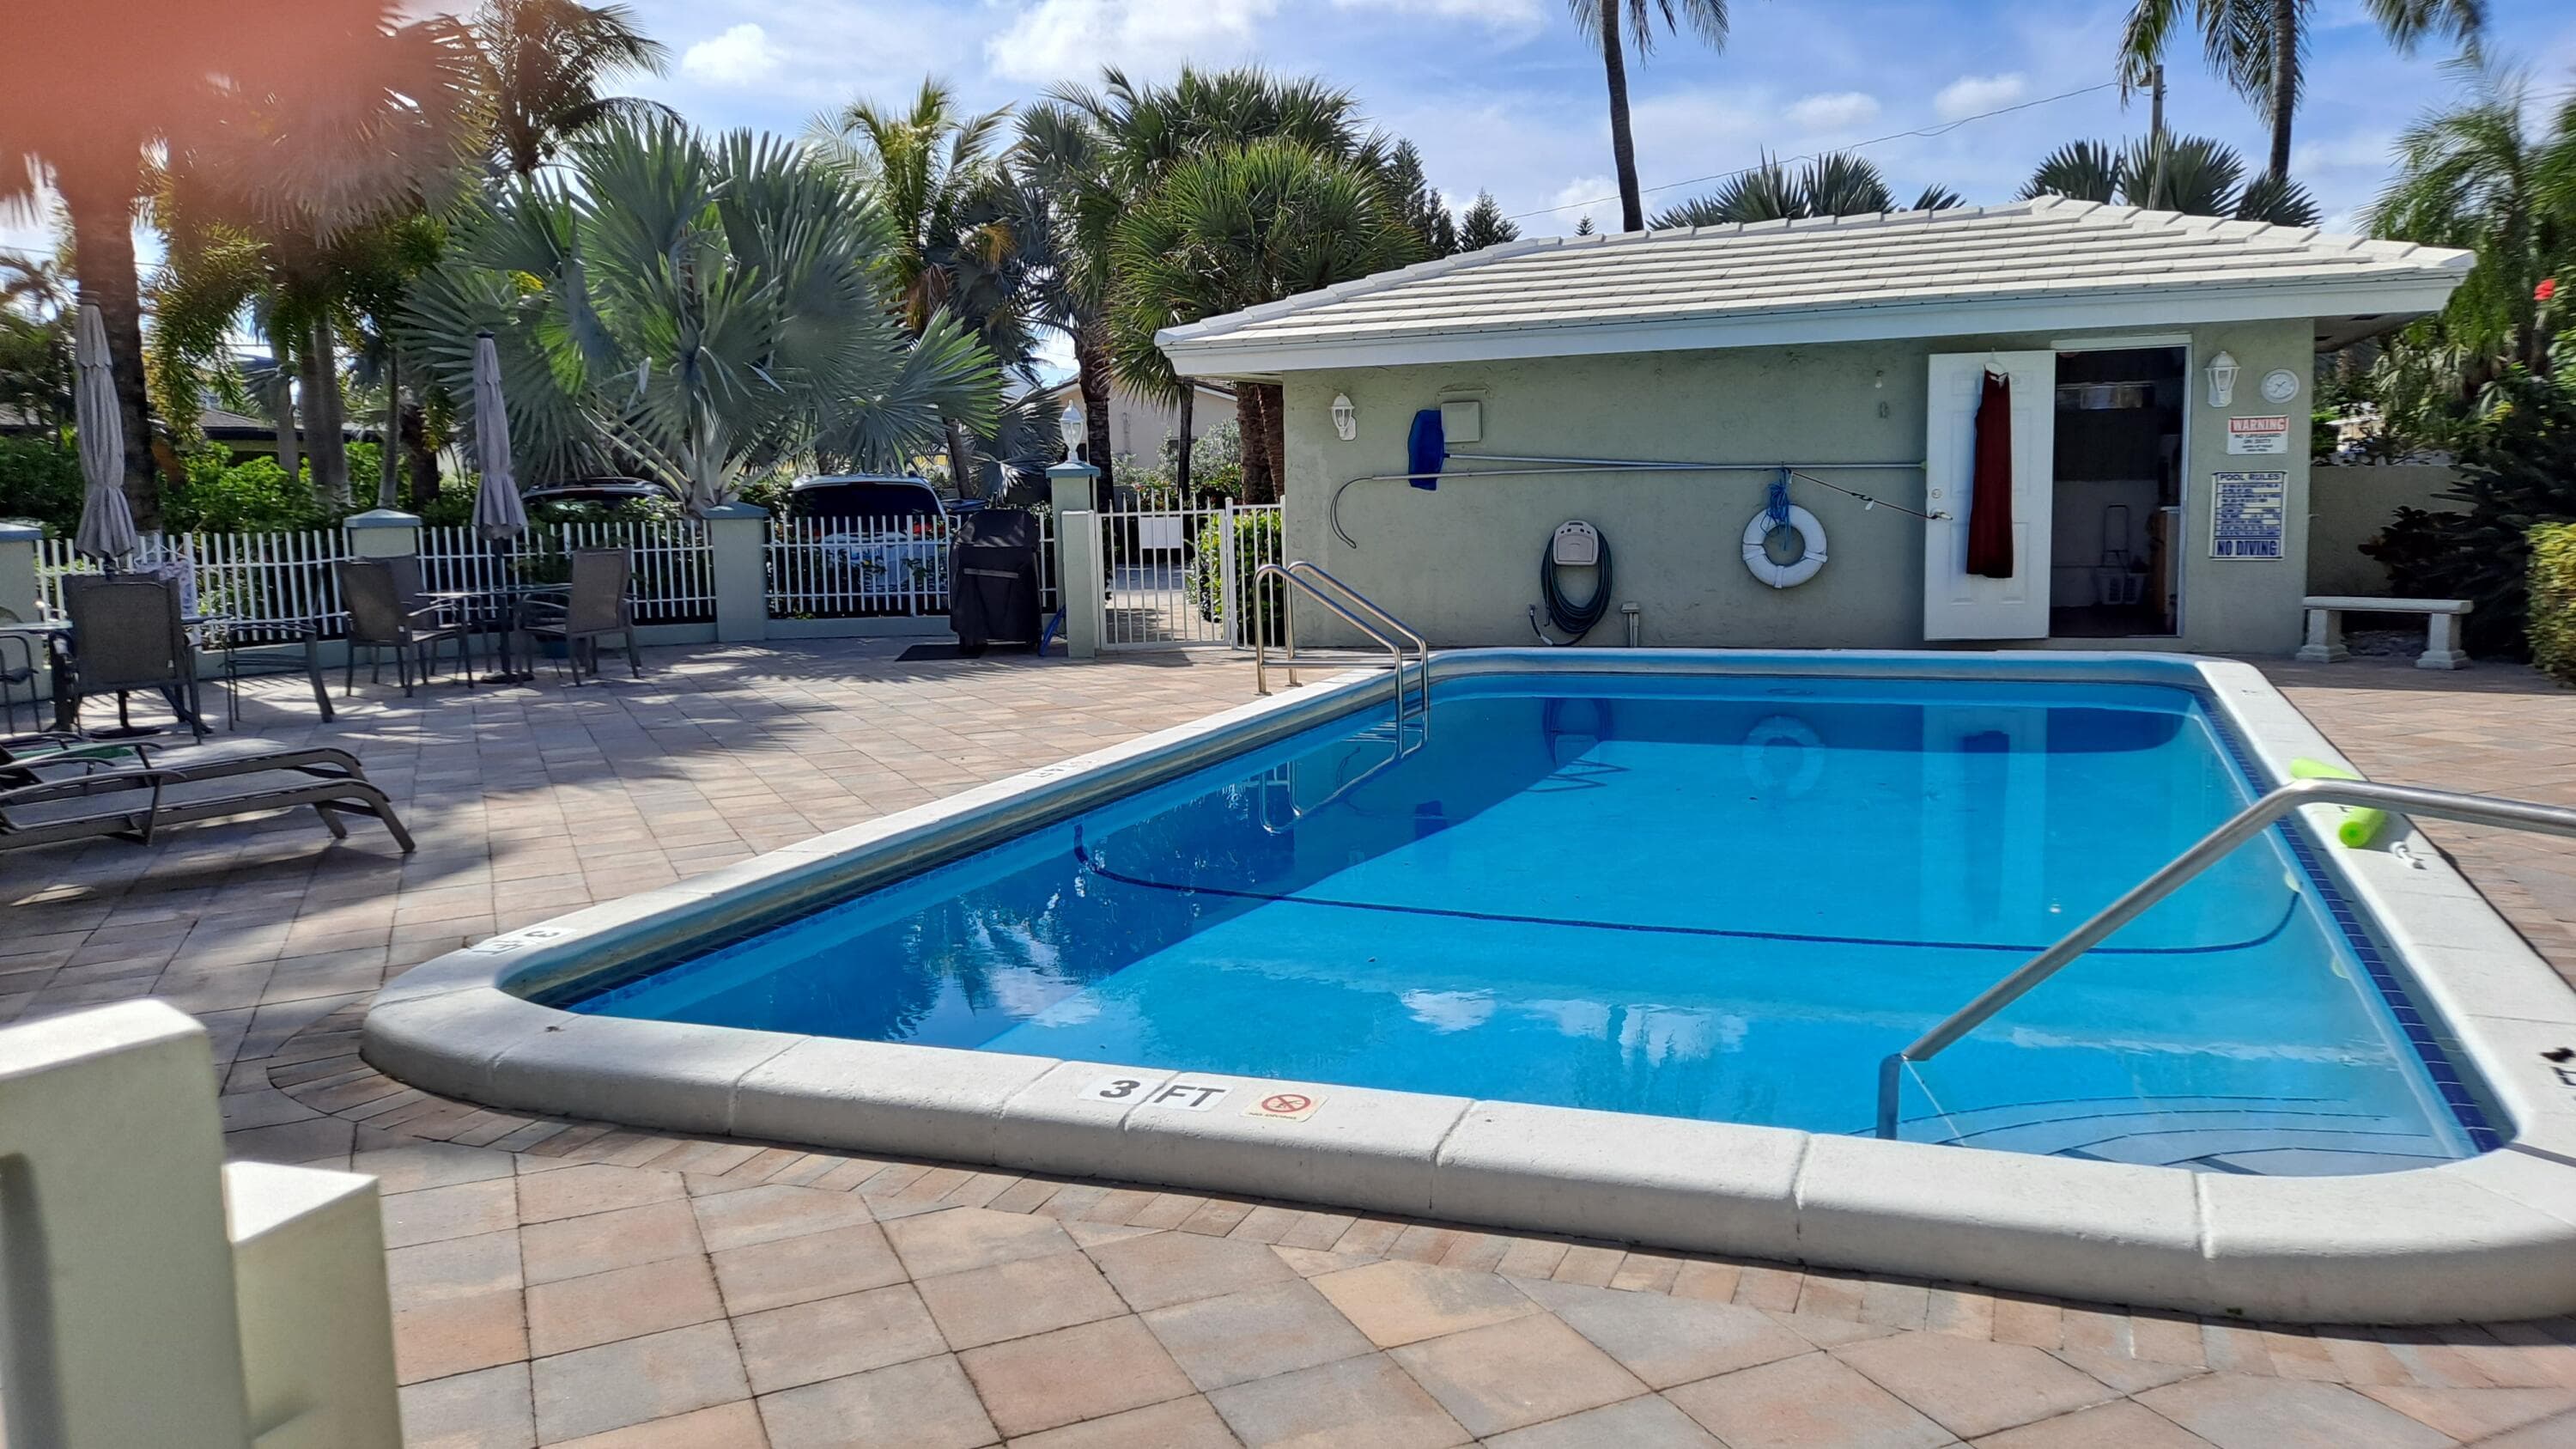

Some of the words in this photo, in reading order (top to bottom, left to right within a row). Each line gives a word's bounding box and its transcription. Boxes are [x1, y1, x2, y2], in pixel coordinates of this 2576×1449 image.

[2233, 418, 2285, 432] WARNING
[2217, 540, 2233, 556] NO
[2236, 540, 2278, 556] DIVING
[1099, 1080, 1141, 1099] 3
[1153, 1085, 1226, 1108] FT
